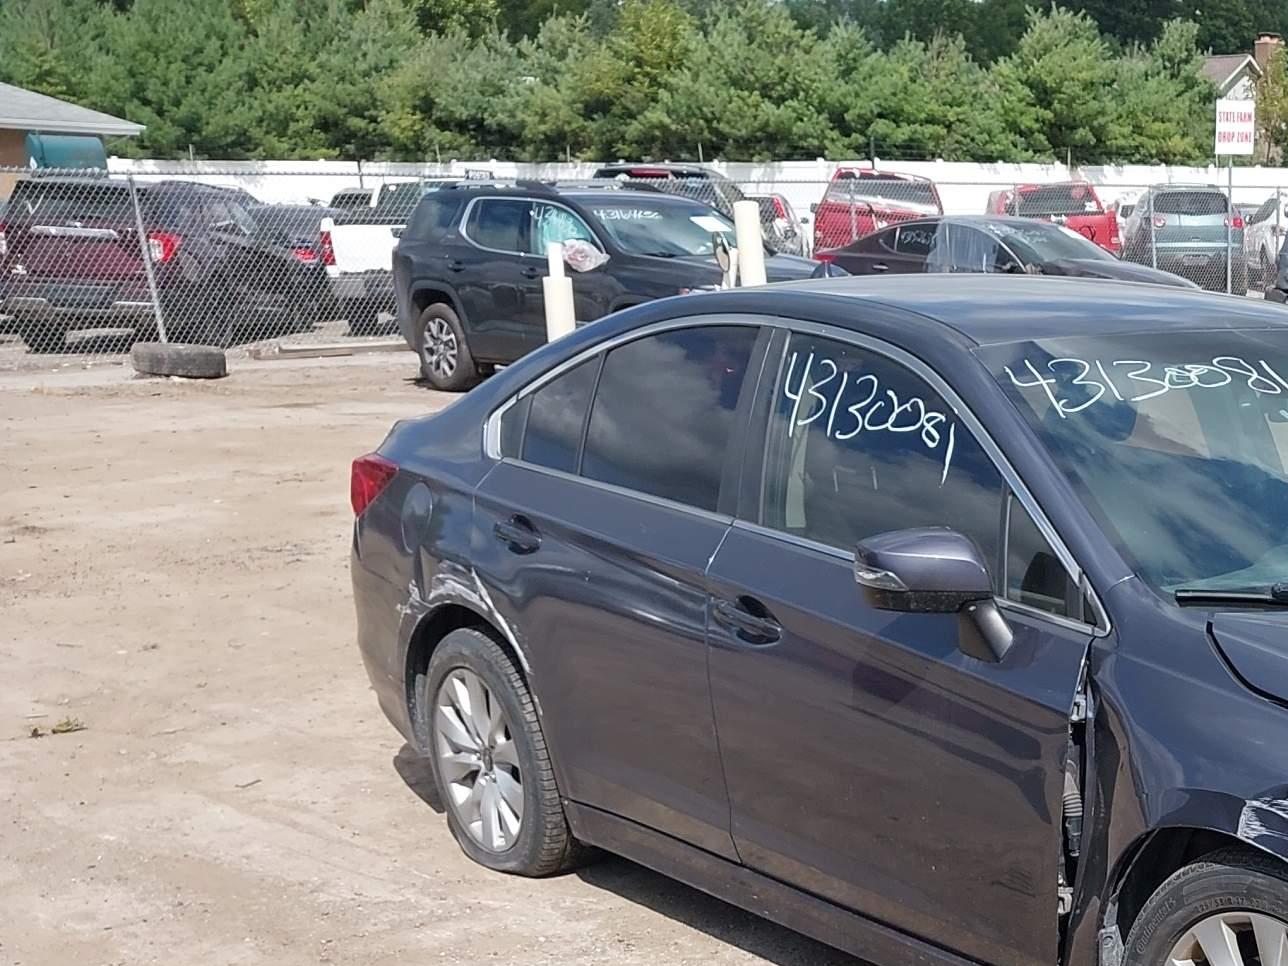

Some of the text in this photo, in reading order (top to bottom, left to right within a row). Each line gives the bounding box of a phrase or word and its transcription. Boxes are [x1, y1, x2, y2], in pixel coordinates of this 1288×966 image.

[1218, 111, 1252, 123] STATE FARM
[1217, 131, 1235, 143] DROP
[784, 352, 955, 485] 43130081
